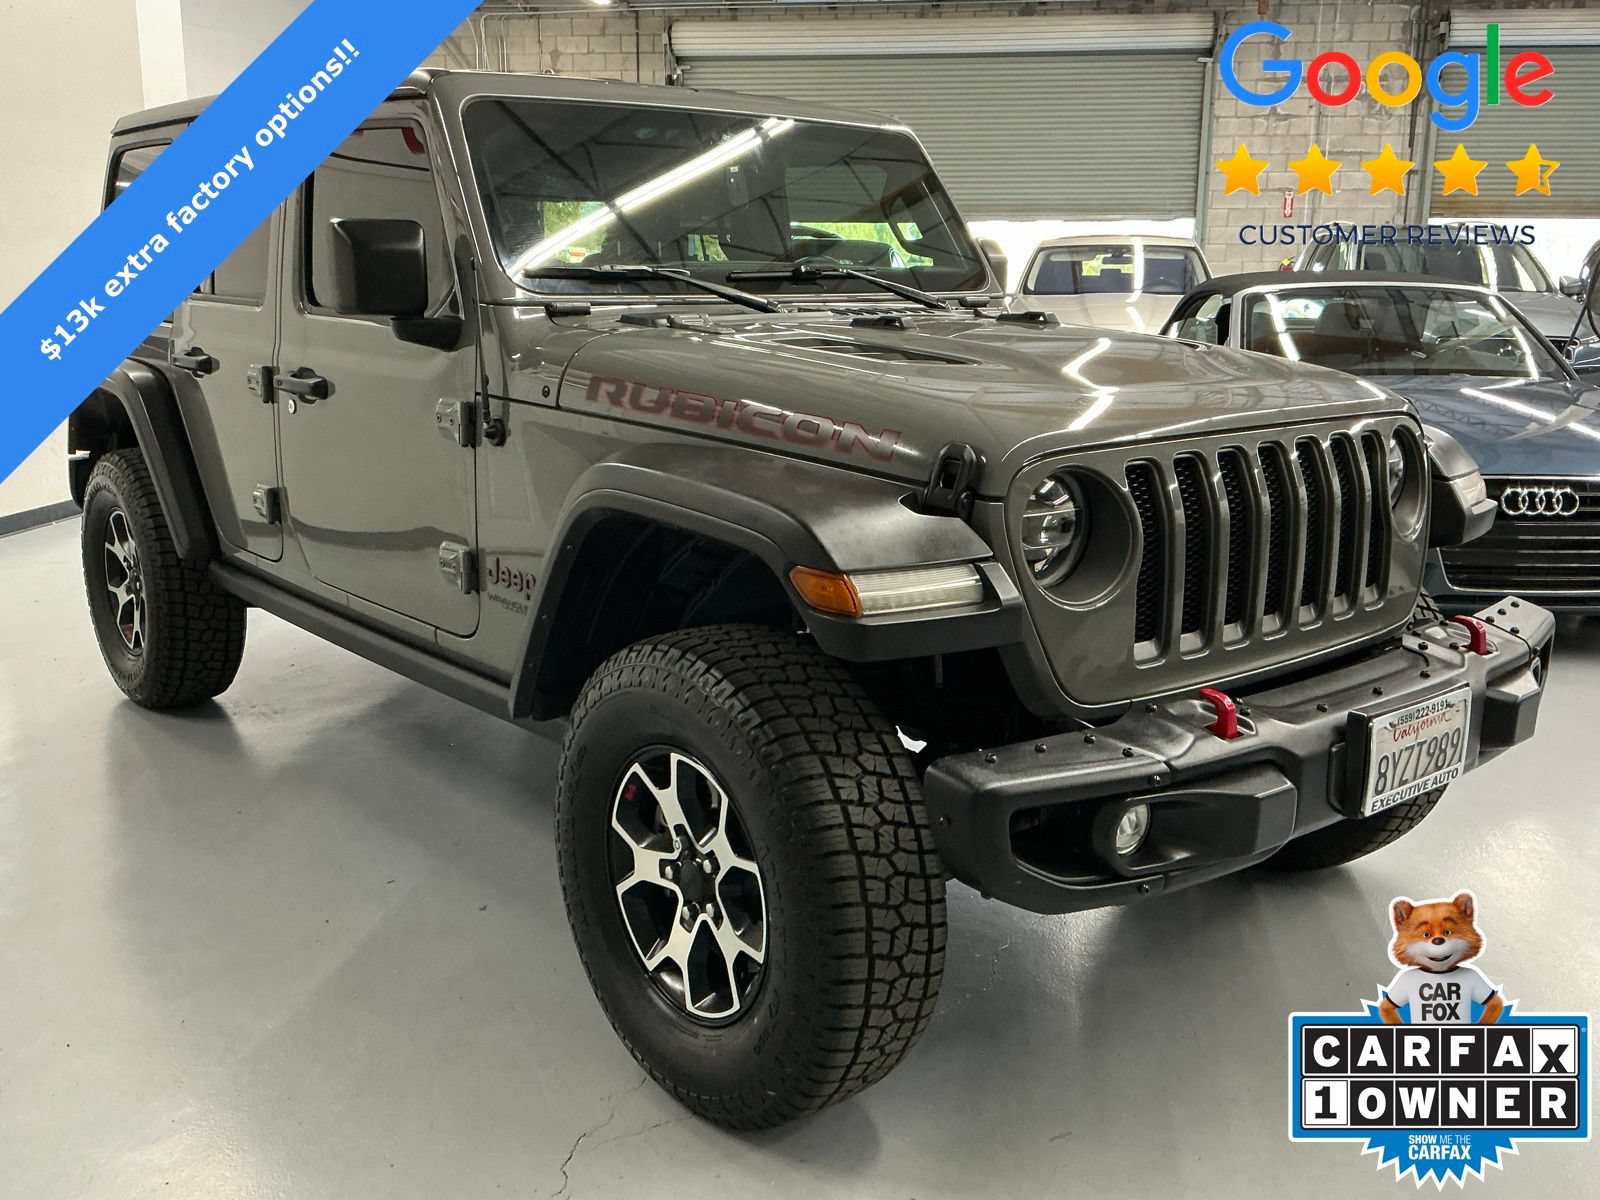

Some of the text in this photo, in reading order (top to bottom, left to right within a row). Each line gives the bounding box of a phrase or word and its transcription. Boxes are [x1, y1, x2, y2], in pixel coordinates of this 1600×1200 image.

[584, 374, 903, 463] RUBICON
[487, 557, 536, 601] Jeep
[1392, 710, 1452, 742] California
[1374, 727, 1461, 797] 8YZT989
[1370, 767, 1459, 813] EXECUTIVE AUTO
